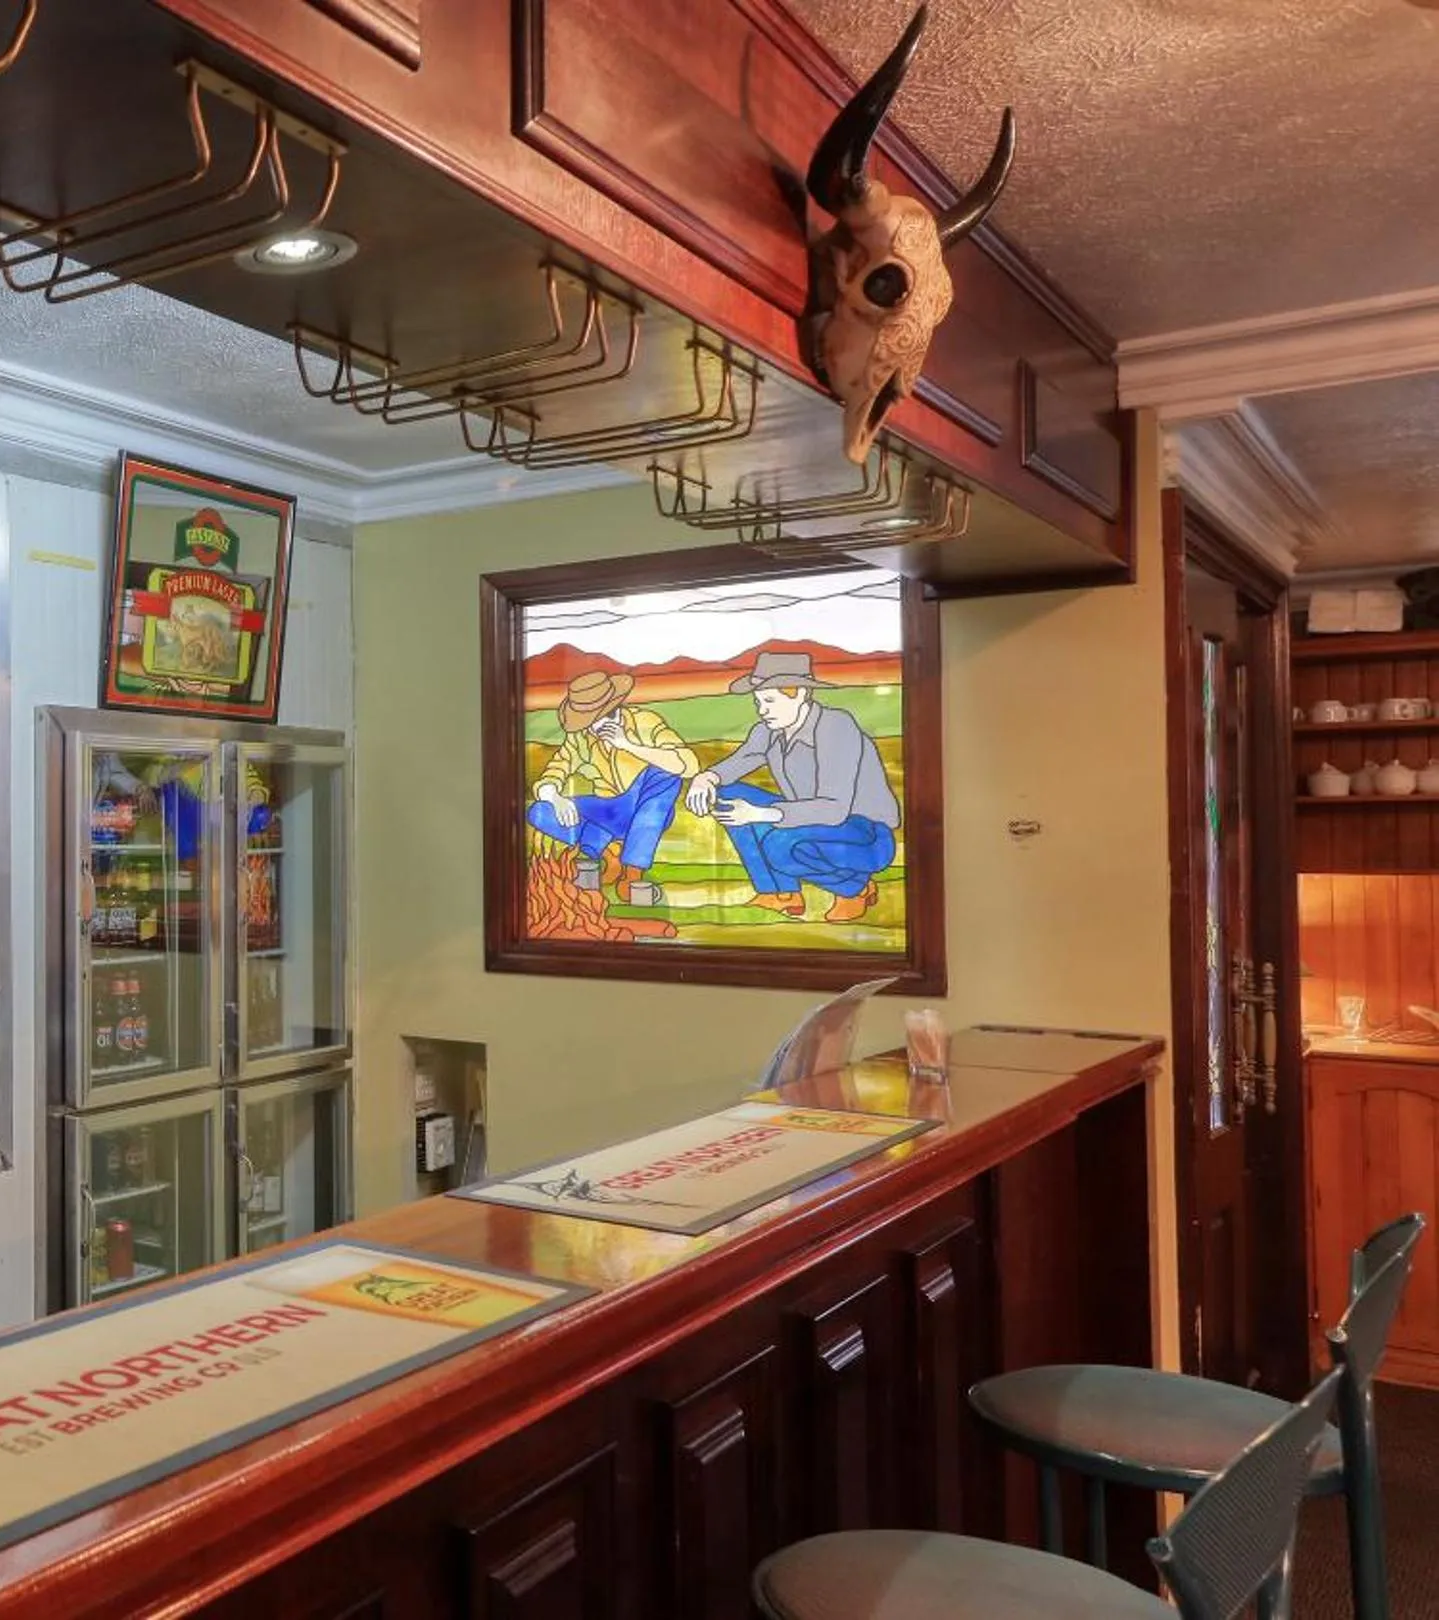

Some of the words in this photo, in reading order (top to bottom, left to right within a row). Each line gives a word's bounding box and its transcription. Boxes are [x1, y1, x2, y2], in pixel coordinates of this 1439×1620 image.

[166, 573, 212, 597] PREMIUM
[34, 1303, 328, 1406] NORTHERN
[48, 1375, 203, 1435] BREWING
